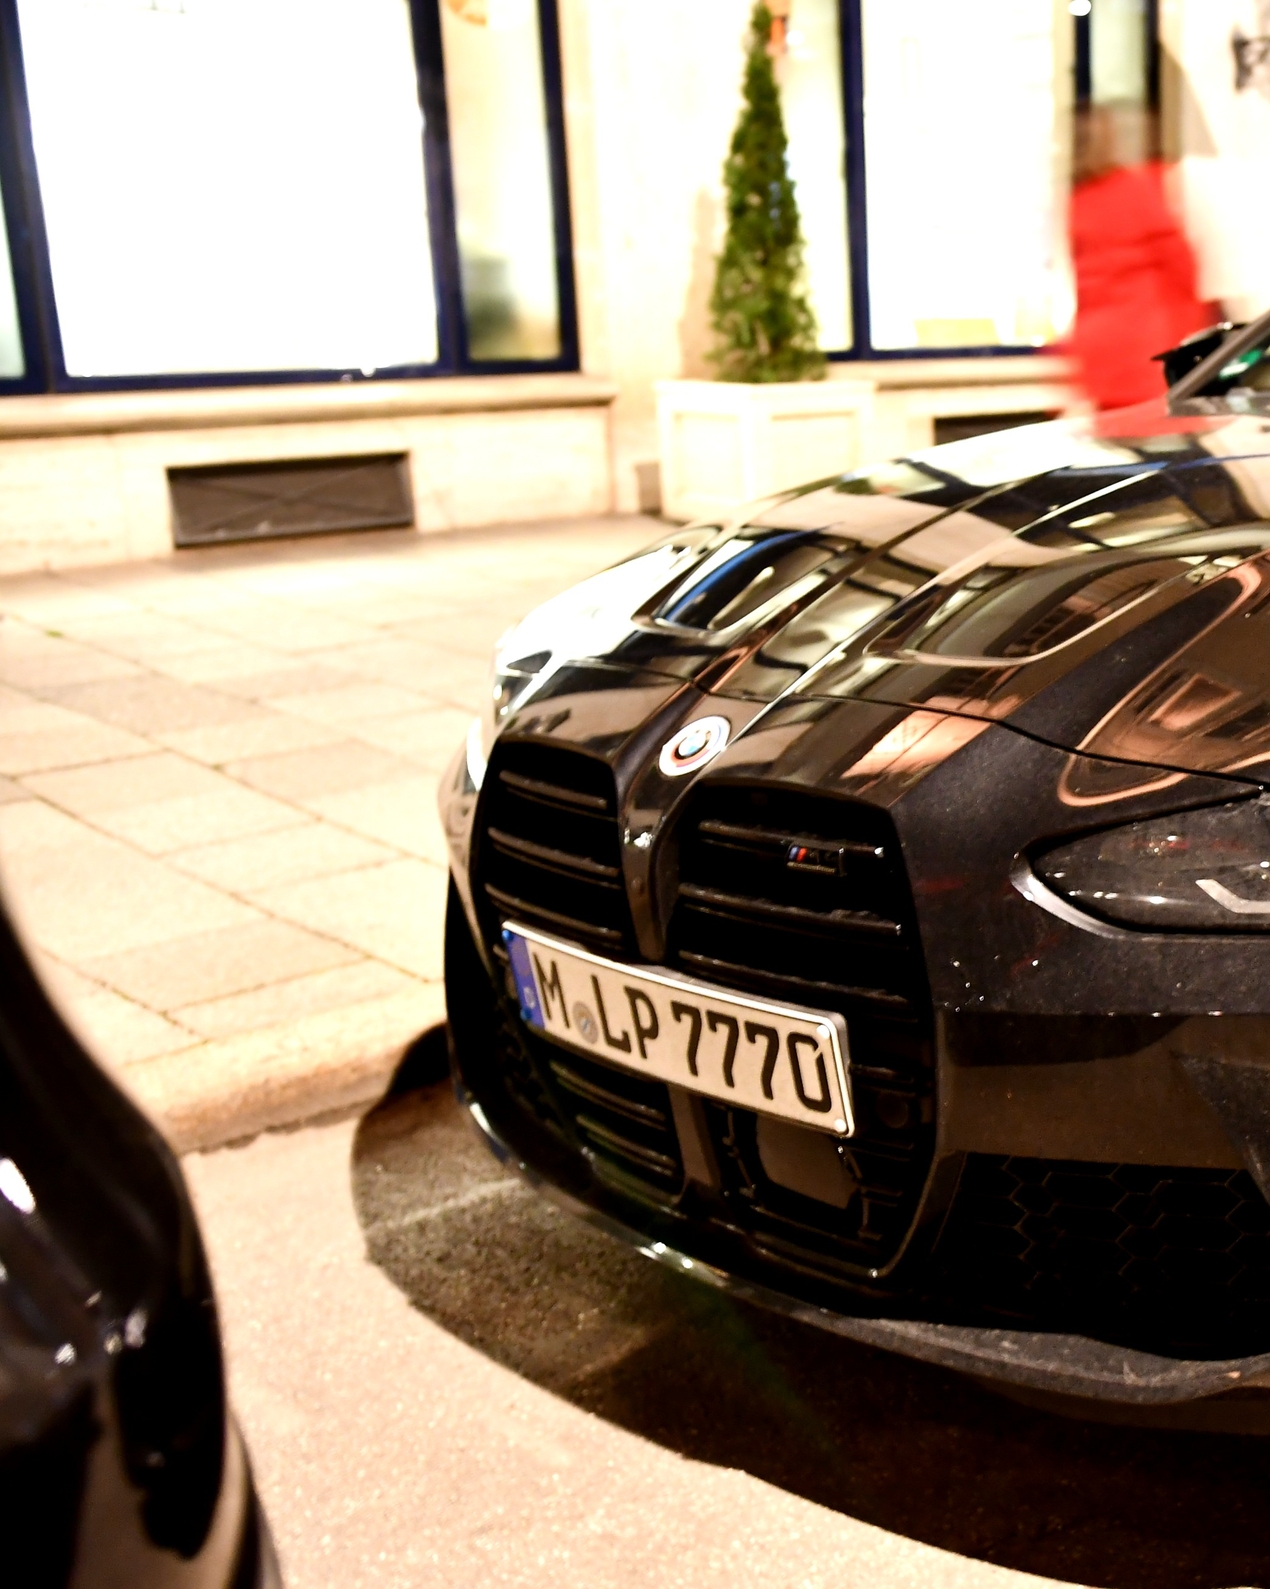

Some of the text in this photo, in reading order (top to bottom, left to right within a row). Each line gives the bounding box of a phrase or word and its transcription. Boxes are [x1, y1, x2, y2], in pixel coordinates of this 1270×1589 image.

[532, 952, 833, 1113] M LP 7770
